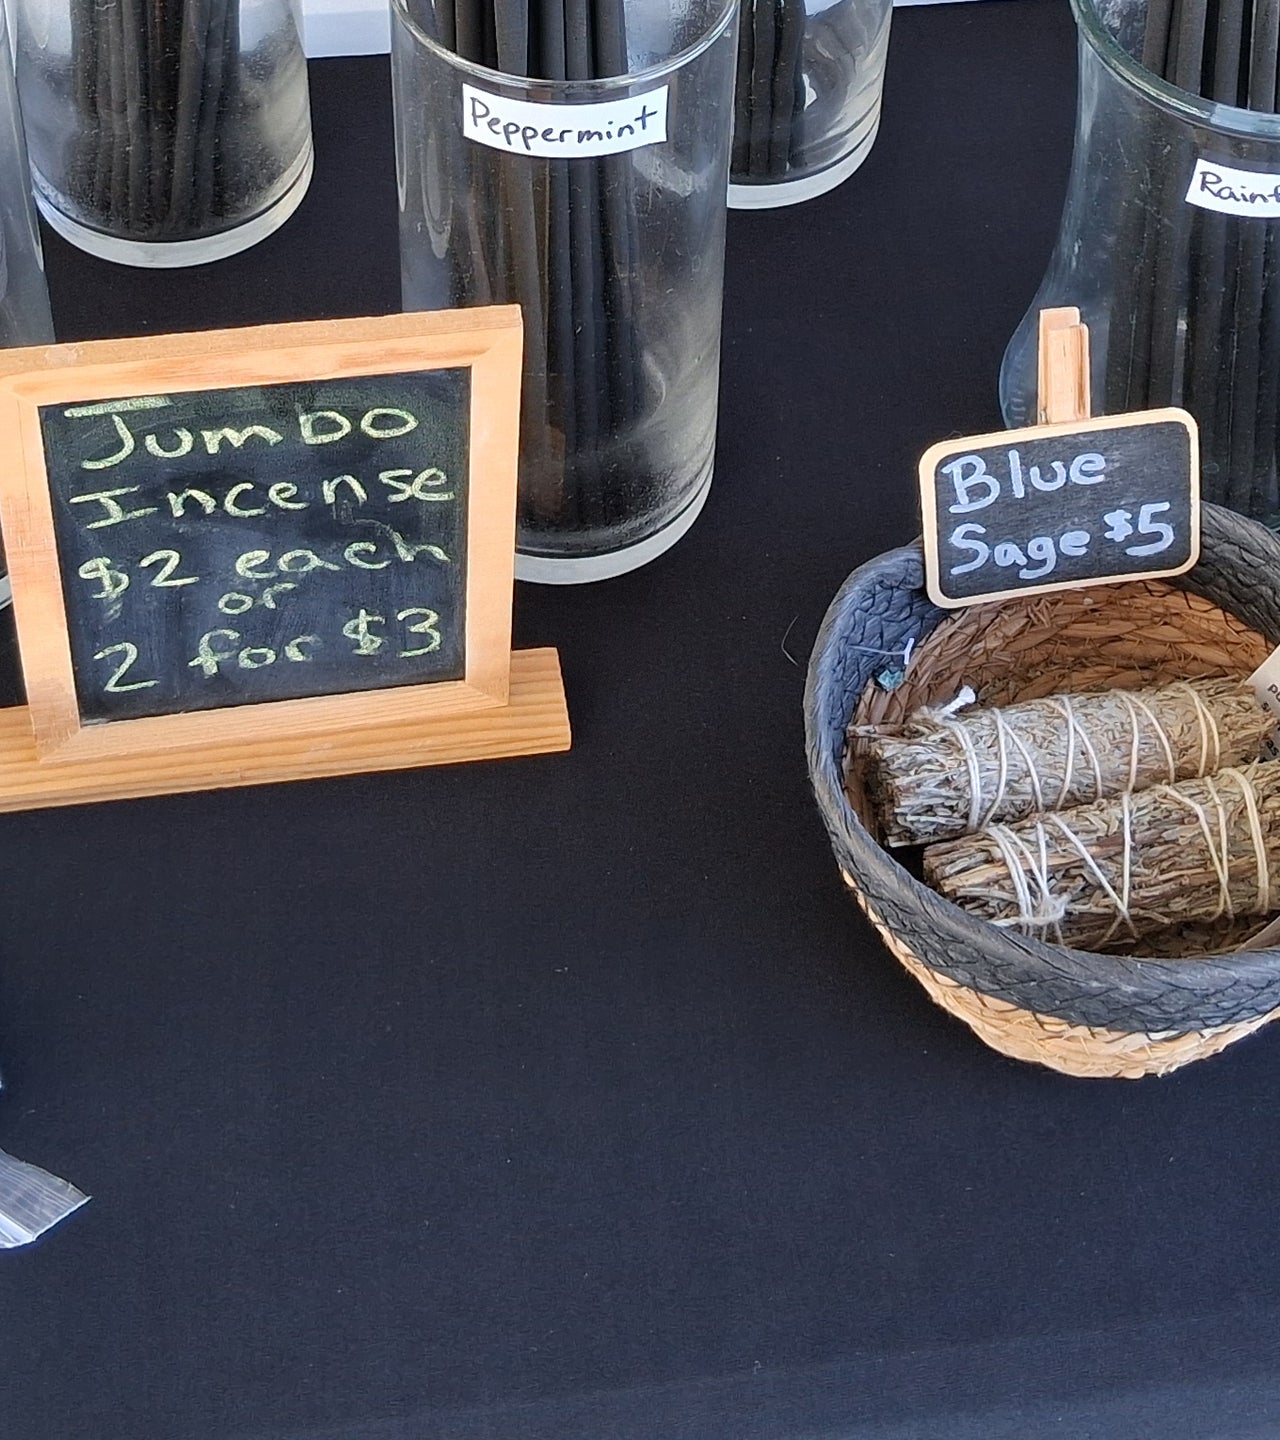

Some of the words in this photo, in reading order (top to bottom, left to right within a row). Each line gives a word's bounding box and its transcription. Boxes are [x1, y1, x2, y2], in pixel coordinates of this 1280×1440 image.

[469, 96, 658, 151] Peppermint
[67, 466, 456, 530] Incense
[940, 448, 1107, 515] Blue
[77, 548, 200, 601] $2
[234, 527, 452, 580] each
[948, 522, 1092, 581] Sage
[1102, 500, 1176, 558] $5
[217, 580, 298, 616] or
[92, 641, 160, 694] 2
[187, 628, 321, 677] for
[341, 606, 443, 660] $3
